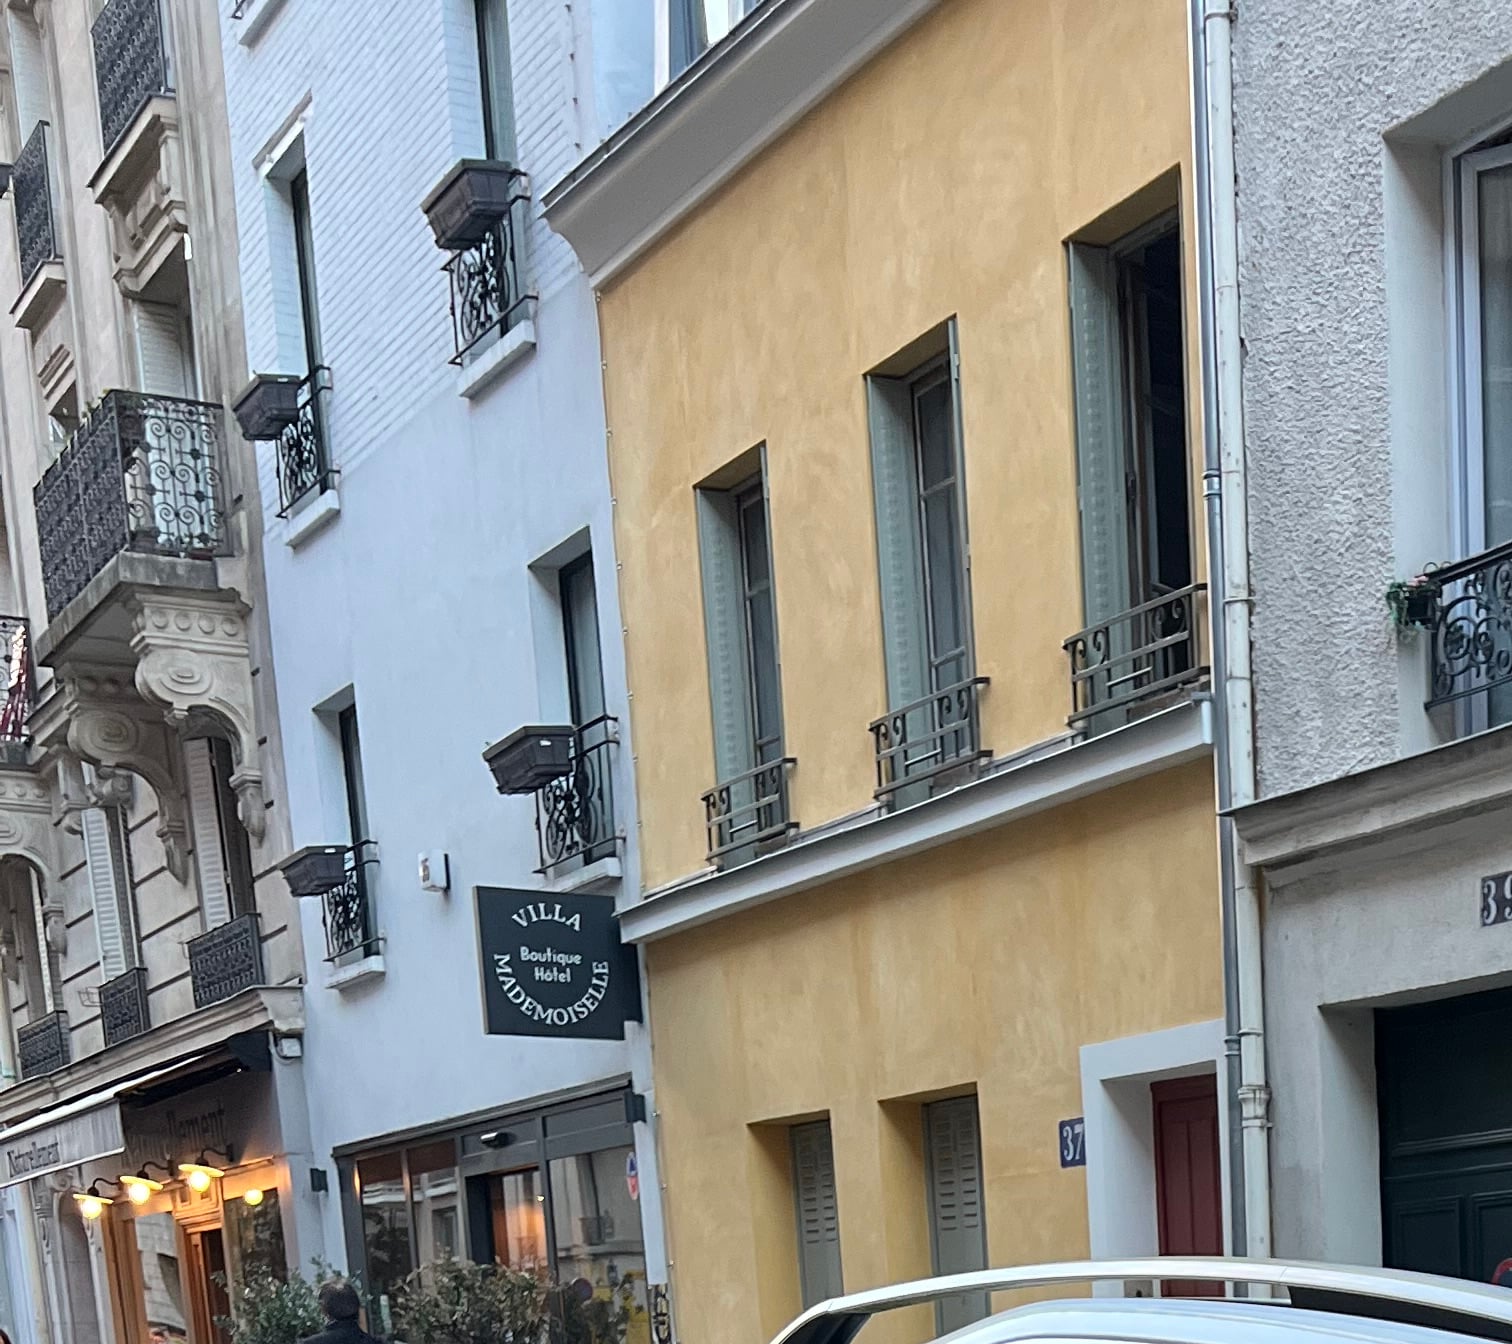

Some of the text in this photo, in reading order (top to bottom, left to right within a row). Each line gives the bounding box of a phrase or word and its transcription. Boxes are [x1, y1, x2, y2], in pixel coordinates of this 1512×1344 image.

[511, 902, 582, 931] VILLA
[519, 946, 582, 966] Boutique
[494, 953, 609, 1026] MADEMOISELLE
[1062, 1123, 1084, 1161] 37
